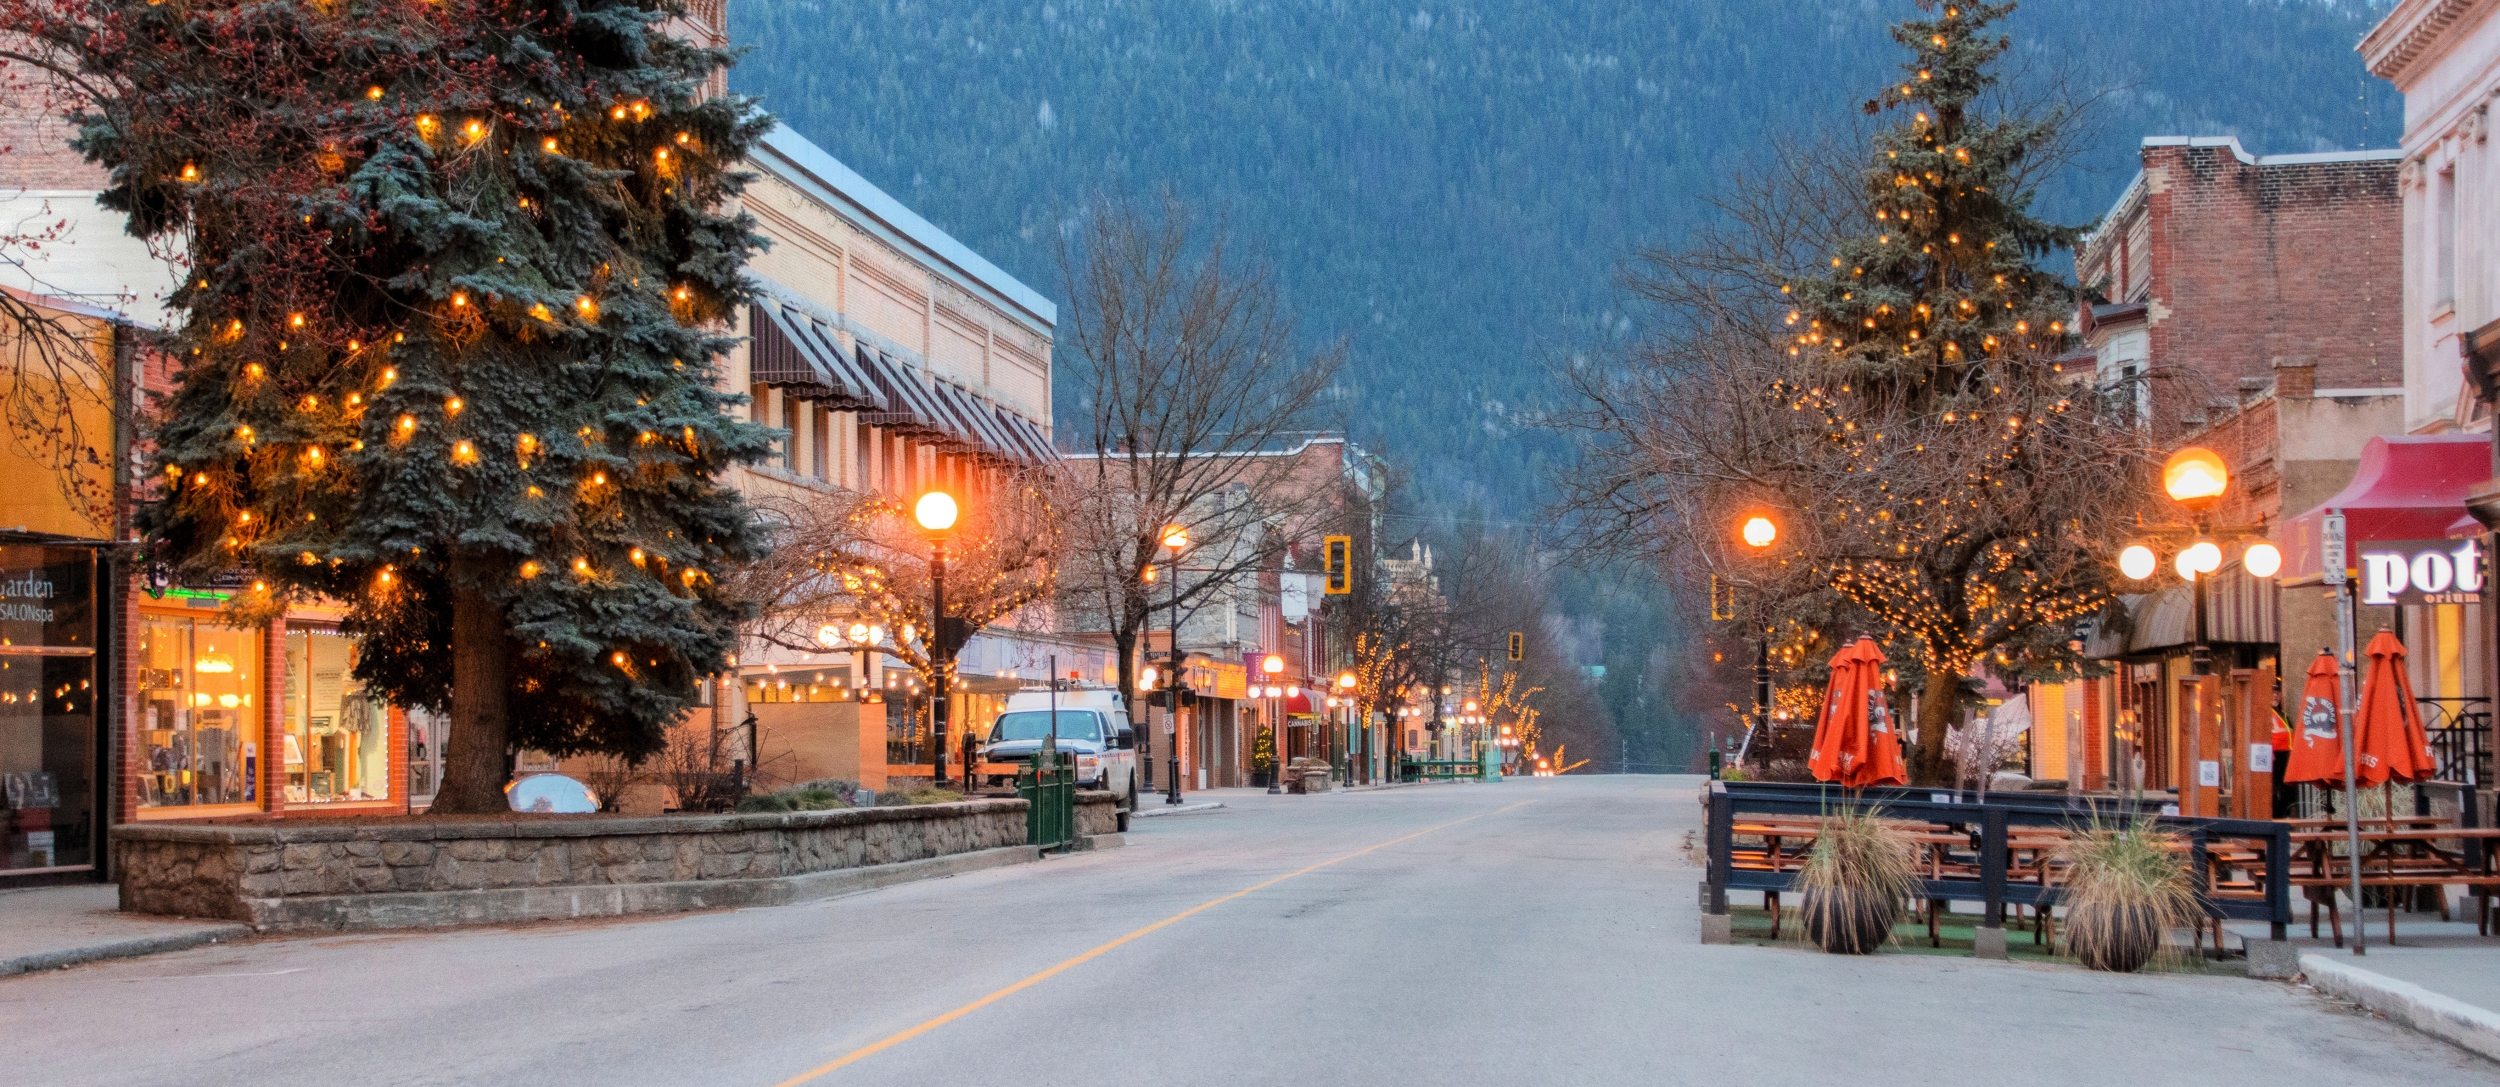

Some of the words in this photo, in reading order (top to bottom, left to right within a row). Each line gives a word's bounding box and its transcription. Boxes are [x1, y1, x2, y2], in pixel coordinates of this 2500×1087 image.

[2360, 538, 2483, 605] pot
[2424, 591, 2480, 604] orium
[1287, 720, 1312, 728] CANNABIS
